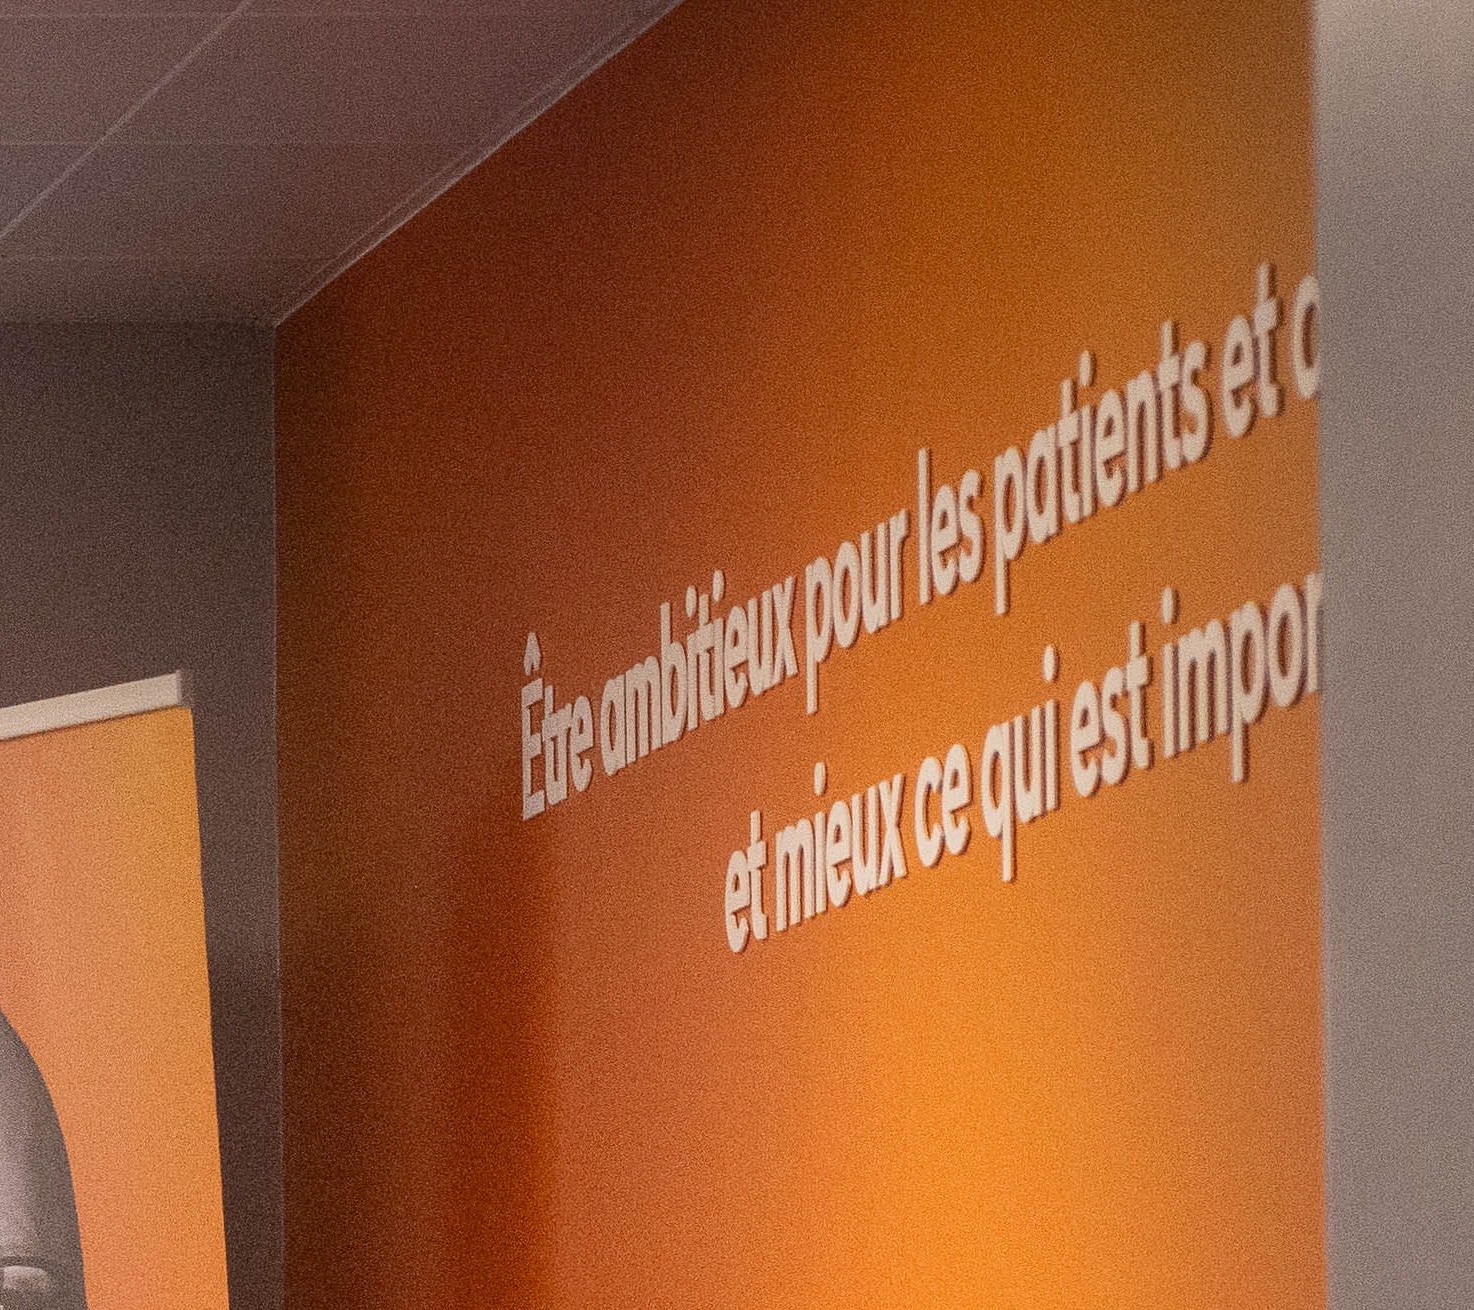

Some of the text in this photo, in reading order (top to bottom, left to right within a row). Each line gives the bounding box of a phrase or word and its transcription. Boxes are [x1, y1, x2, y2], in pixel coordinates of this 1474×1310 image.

[520, 633, 594, 821] Être
[600, 569, 800, 778] ambitieux
[804, 506, 912, 715] pour
[918, 448, 985, 606] les
[993, 318, 1210, 615] patients
[1221, 262, 1281, 439] et
[724, 810, 767, 952] et
[775, 762, 904, 930] mieux
[915, 743, 970, 867] ce
[980, 645, 1061, 881] qui
[1069, 621, 1153, 798] est
